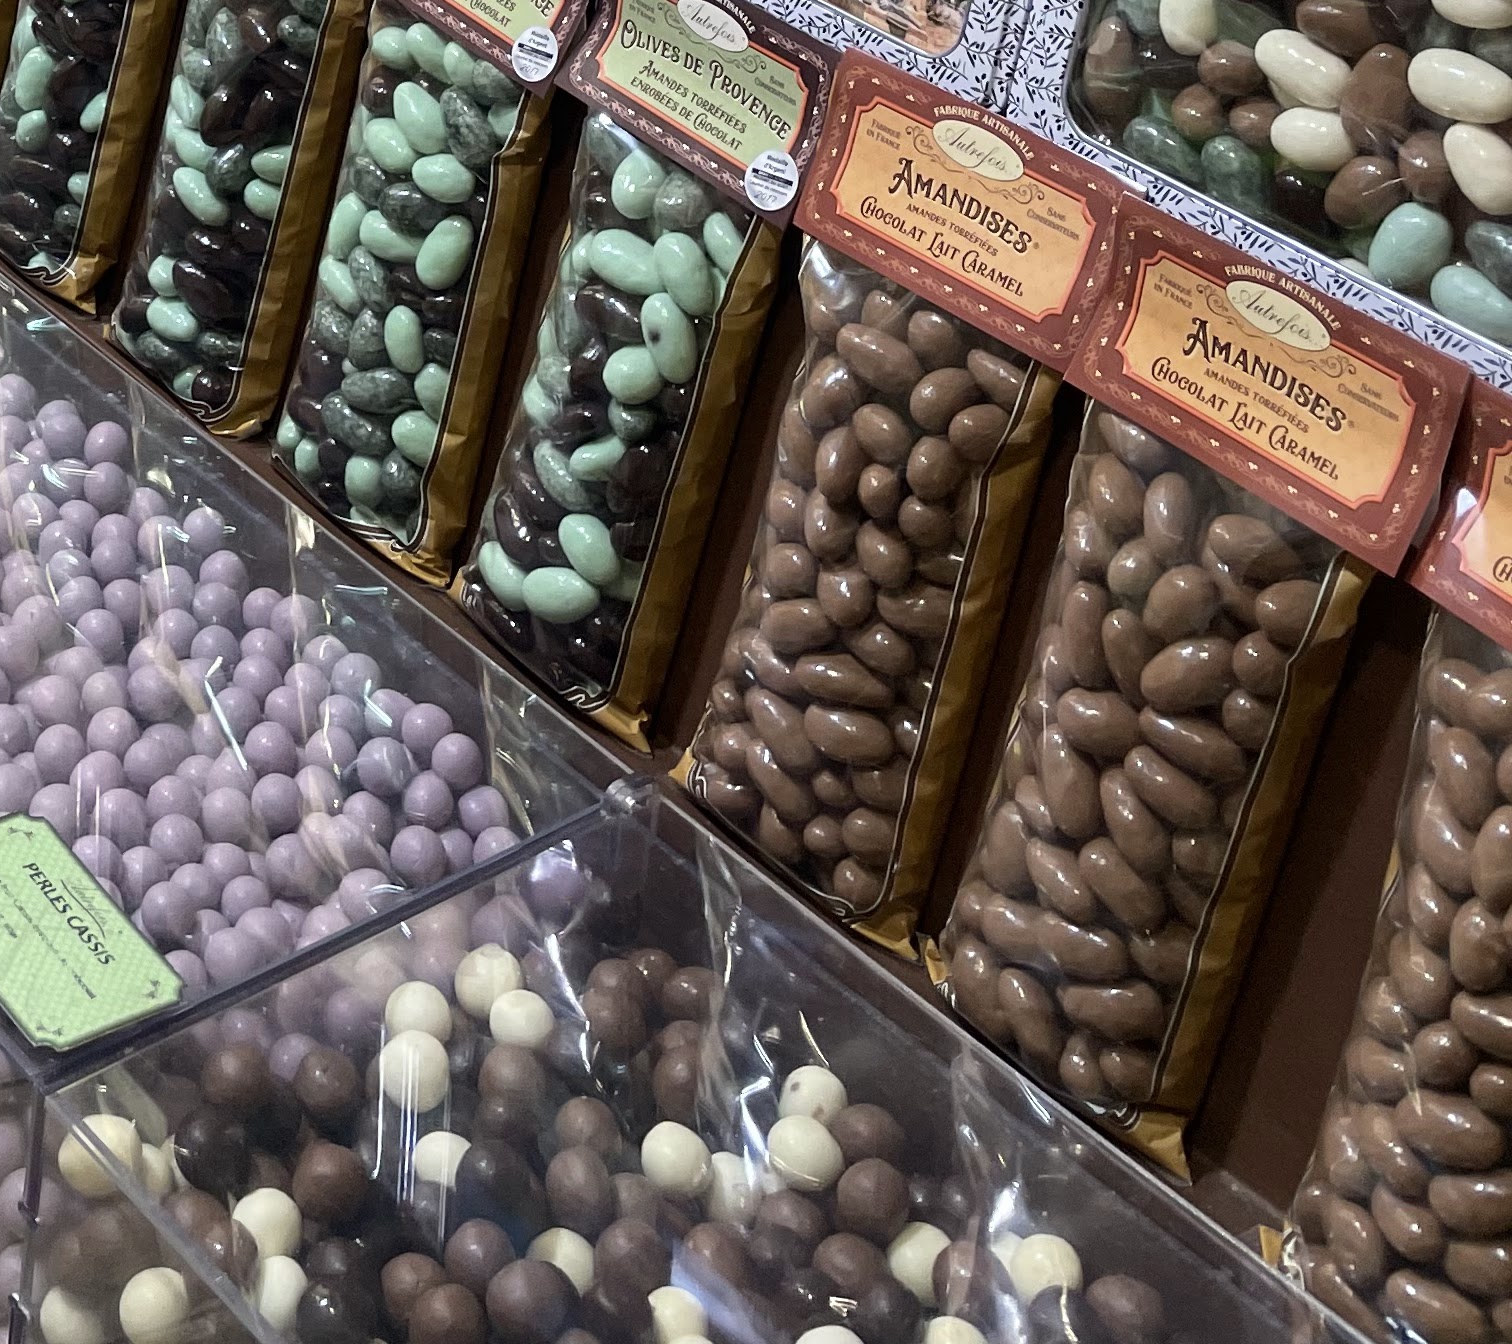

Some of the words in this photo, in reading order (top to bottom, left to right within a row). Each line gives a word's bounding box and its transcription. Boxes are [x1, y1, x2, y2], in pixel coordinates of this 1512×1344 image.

[620, 19, 680, 64] OLIVES
[683, 52, 704, 76] DE
[708, 59, 792, 141] PROVENCE
[631, 77, 678, 113] ENROBÉES
[693, 112, 744, 151] CHOCOLAT
[639, 60, 689, 99] AMANDES
[875, 132, 901, 151] FRANCE
[933, 106, 980, 121] FABRIQUE
[982, 113, 1036, 161] ARTISANALE
[888, 157, 1033, 254] AMANDISES
[906, 203, 947, 227] AMANDES
[949, 221, 999, 258] TORRÉFIÉES
[860, 196, 927, 242] CHOCOLAT
[926, 231, 961, 261] LAIT
[962, 250, 1024, 297] CARAMEL
[1164, 287, 1194, 310] FRANCE
[1224, 264, 1276, 284] FABRIQUE
[1278, 275, 1342, 332] ARTISANALE
[1182, 316, 1347, 434] AMANDISES
[1203, 368, 1250, 398] AMANDES
[1252, 390, 1310, 434] TORRÉFIÉES
[1151, 356, 1230, 413] CHOCOLAT
[1227, 400, 1267, 436] LAIT
[1268, 424, 1340, 482] CARAMEL
[22, 862, 73, 914] PERLES
[66, 915, 116, 965] CASSIS
